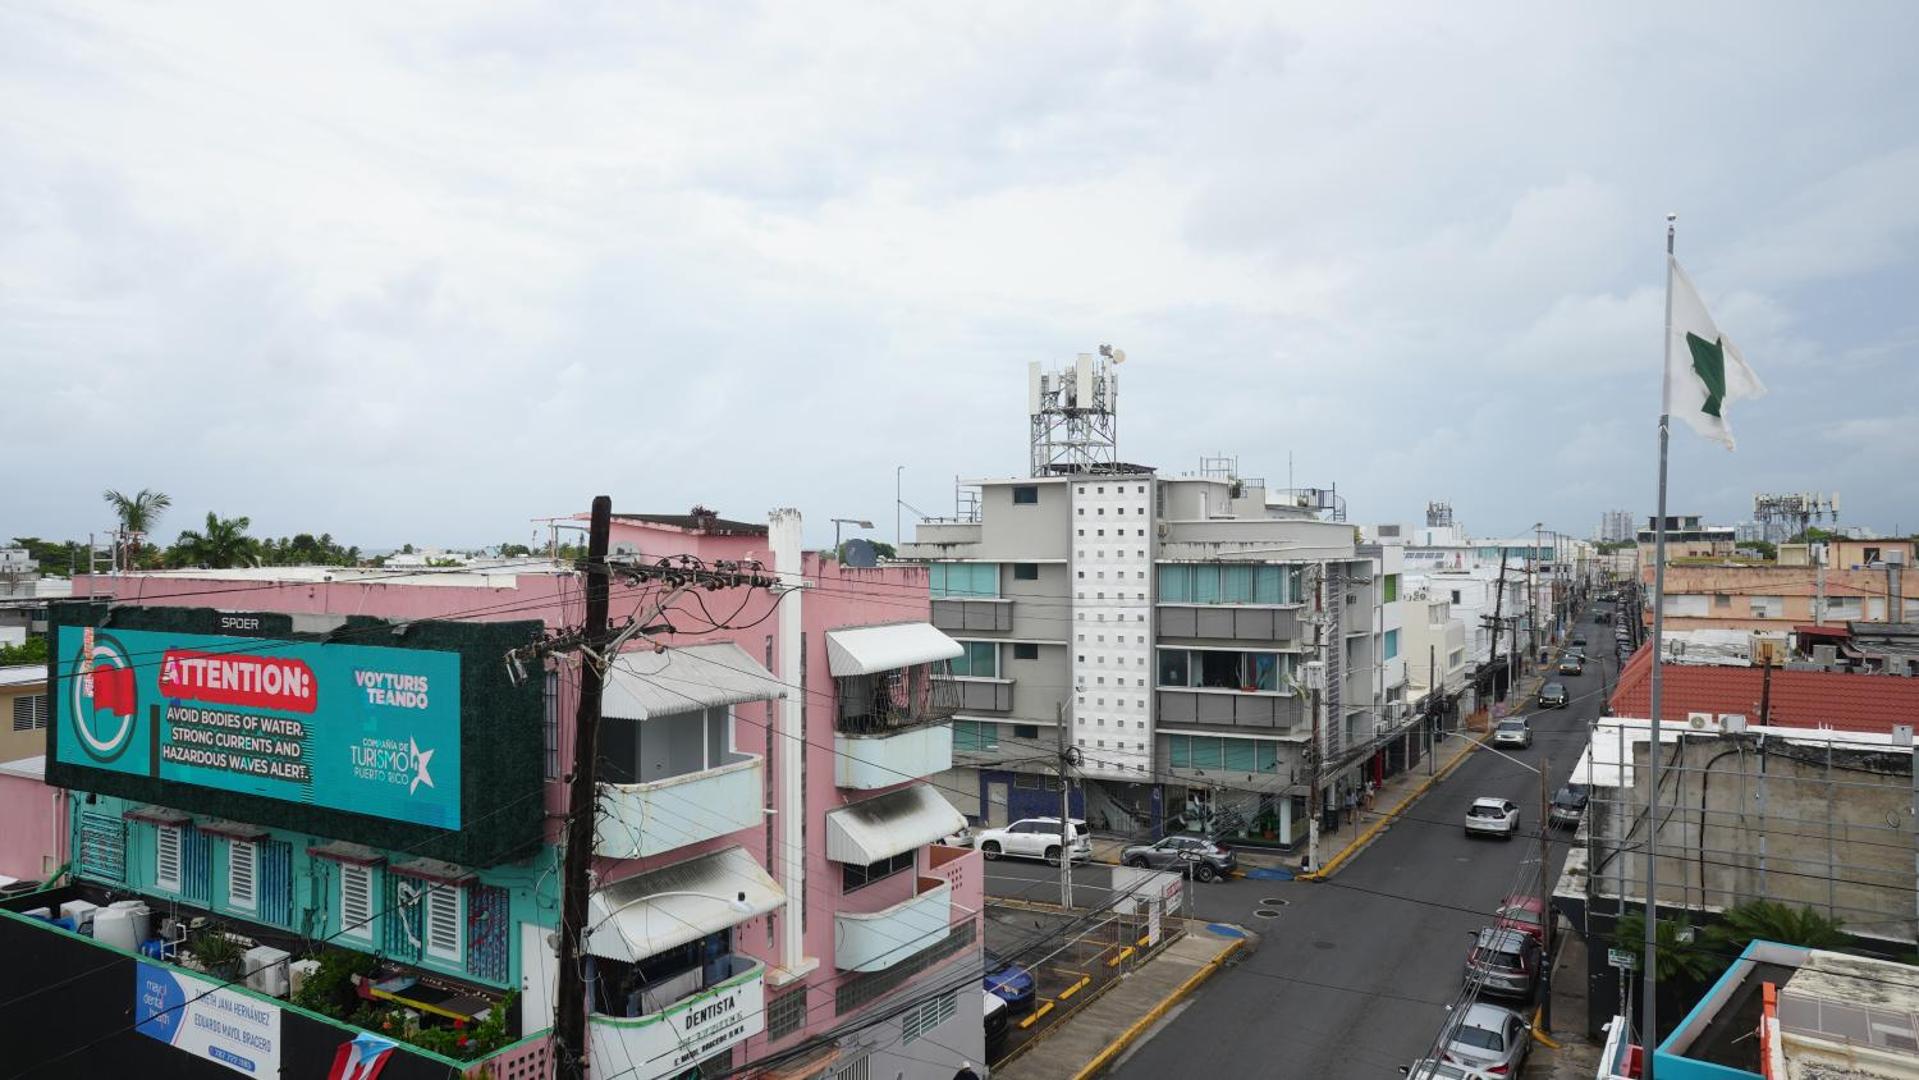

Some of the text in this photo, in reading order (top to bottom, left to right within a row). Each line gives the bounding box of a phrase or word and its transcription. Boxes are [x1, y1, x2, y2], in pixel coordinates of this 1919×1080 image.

[164, 655, 310, 699] ATTENTION:
[366, 688, 429, 710] TEANDO
[166, 706, 199, 723] AVOID
[201, 710, 241, 729] BODIES
[242, 716, 258, 730] OF
[172, 727, 301, 757] STRONG CURRENTS AND
[398, 742, 409, 752] DE
[162, 745, 228, 768] HAZARDOUS
[228, 754, 269, 774] WAVES
[350, 745, 409, 773] TURISMO
[353, 766, 409, 785] PUERTO RICO
[685, 996, 736, 1030] DENTISTA
